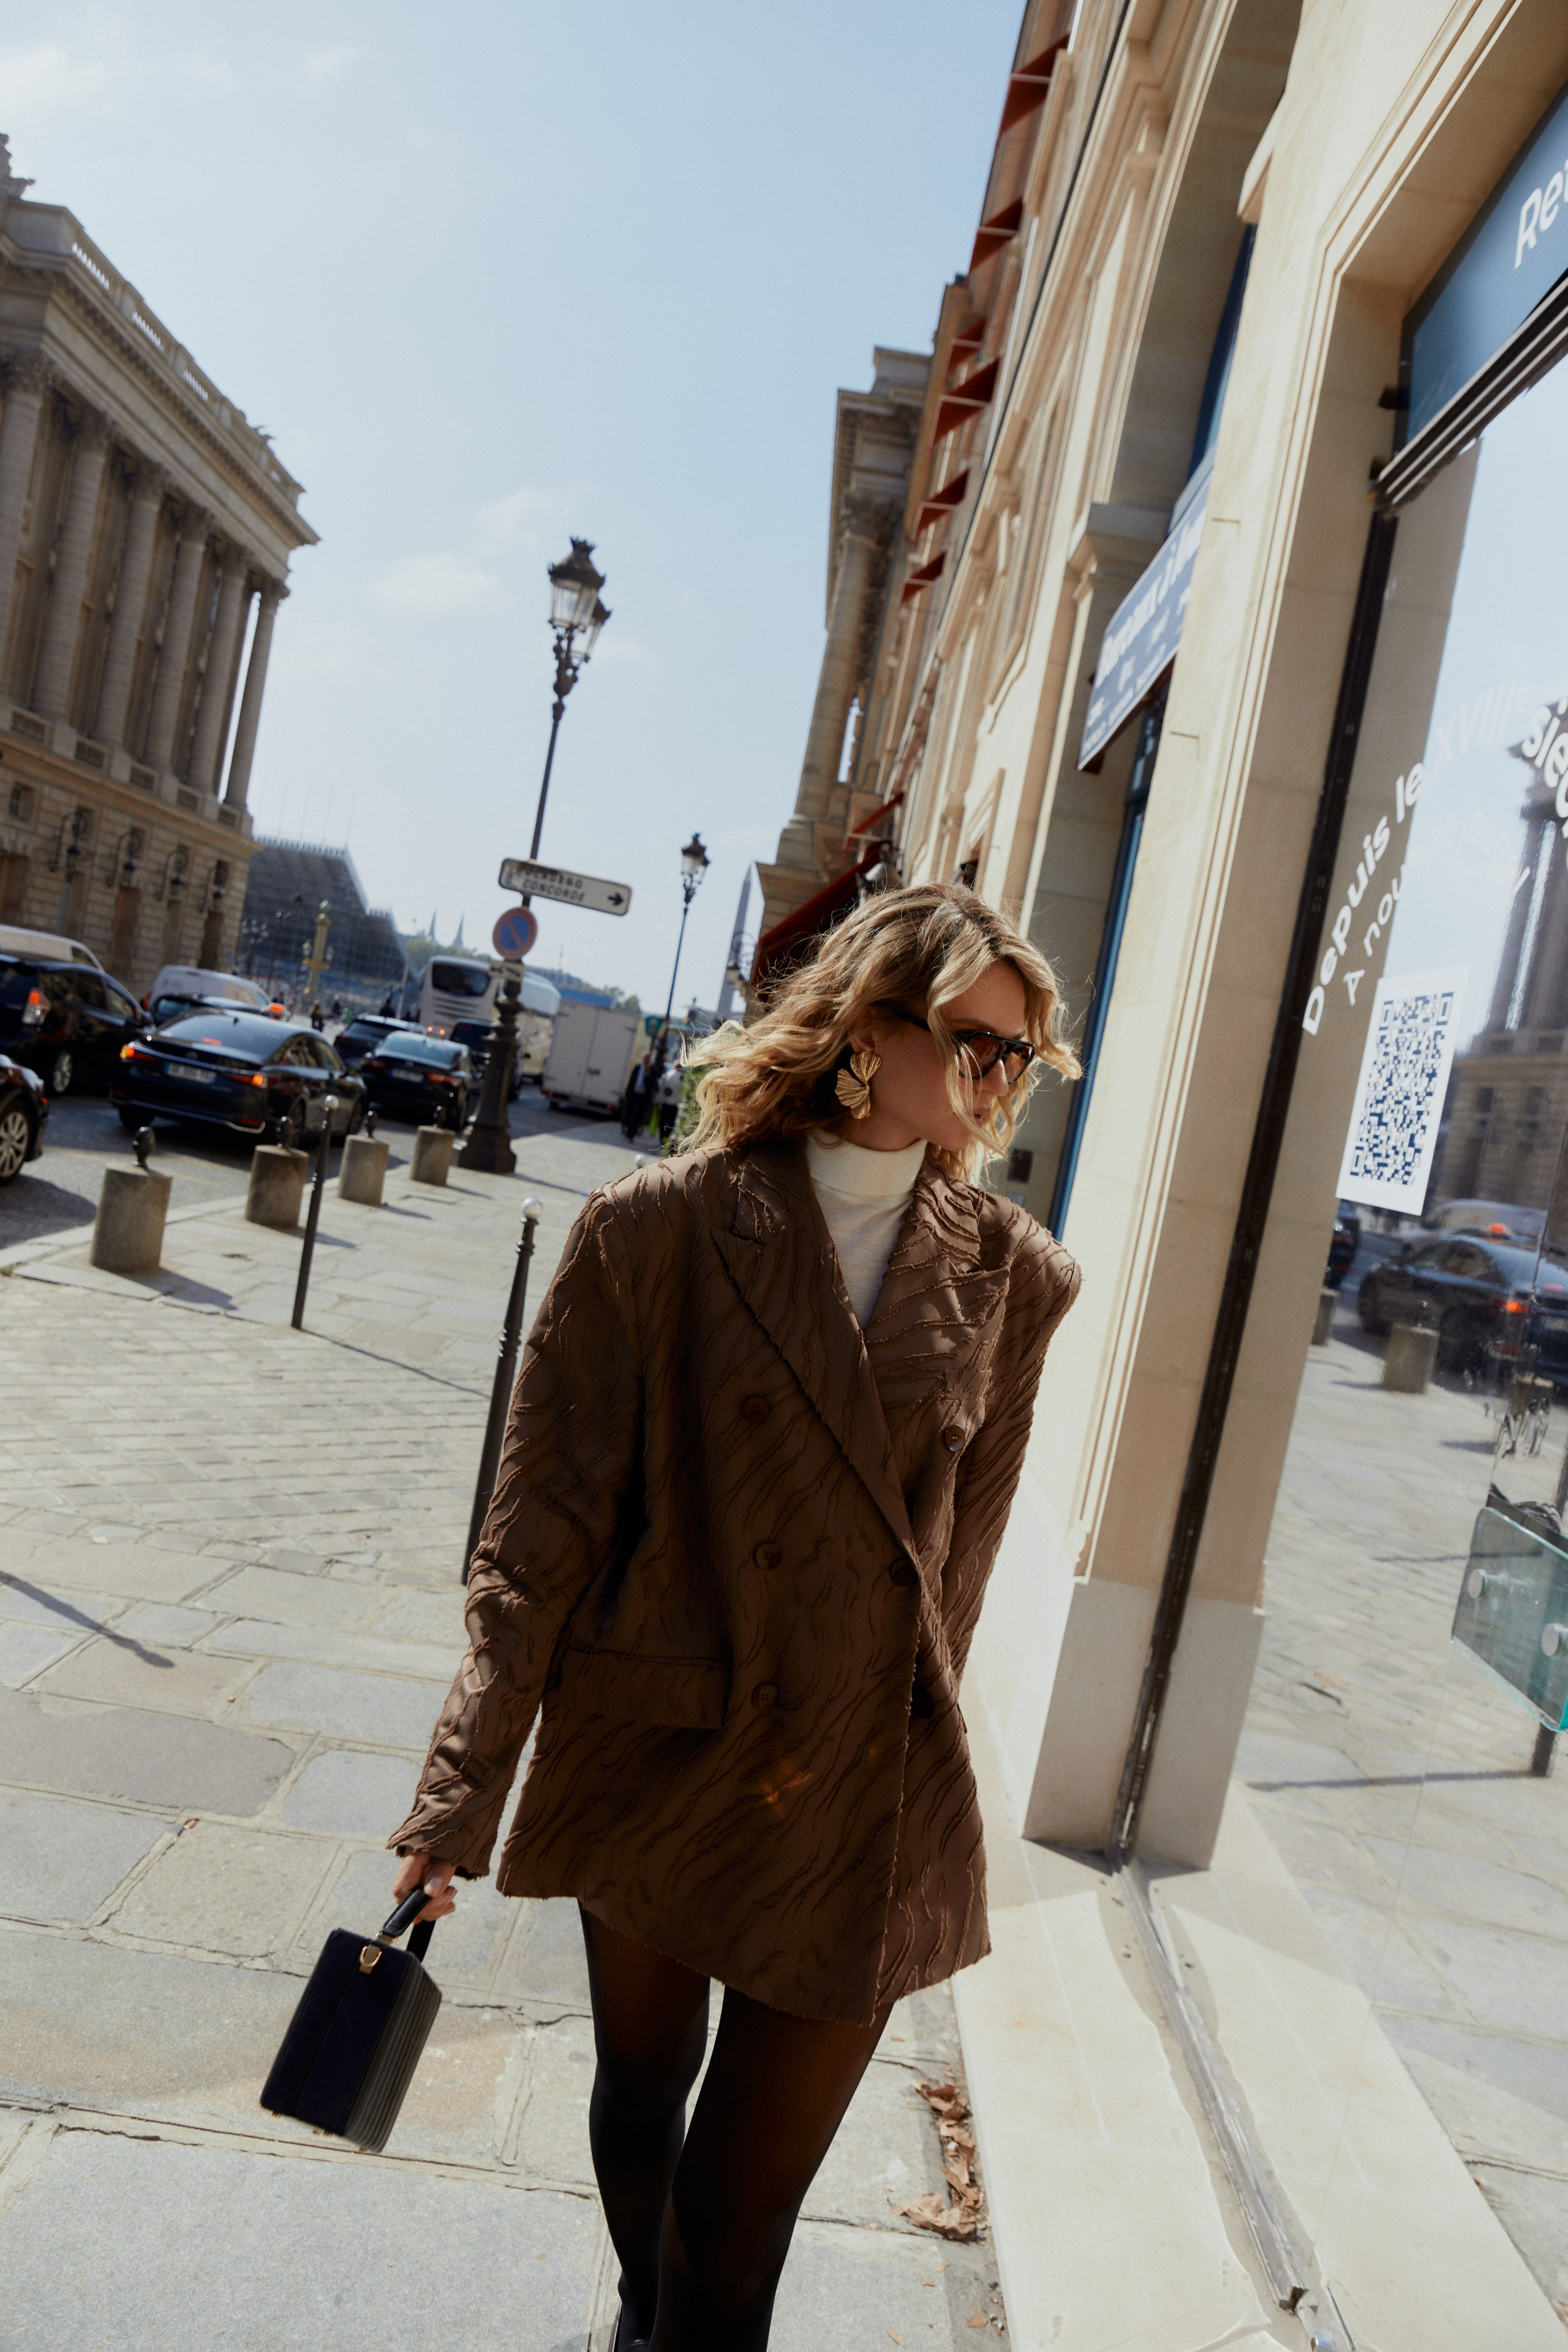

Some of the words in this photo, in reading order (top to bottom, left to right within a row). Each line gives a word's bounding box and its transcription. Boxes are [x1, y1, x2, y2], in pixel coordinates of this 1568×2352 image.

[1514, 159, 1568, 270] Re
[523, 879, 586, 902] CONCORDE
[1302, 815, 1390, 1035] Depuis
[1395, 763, 1424, 823] le
